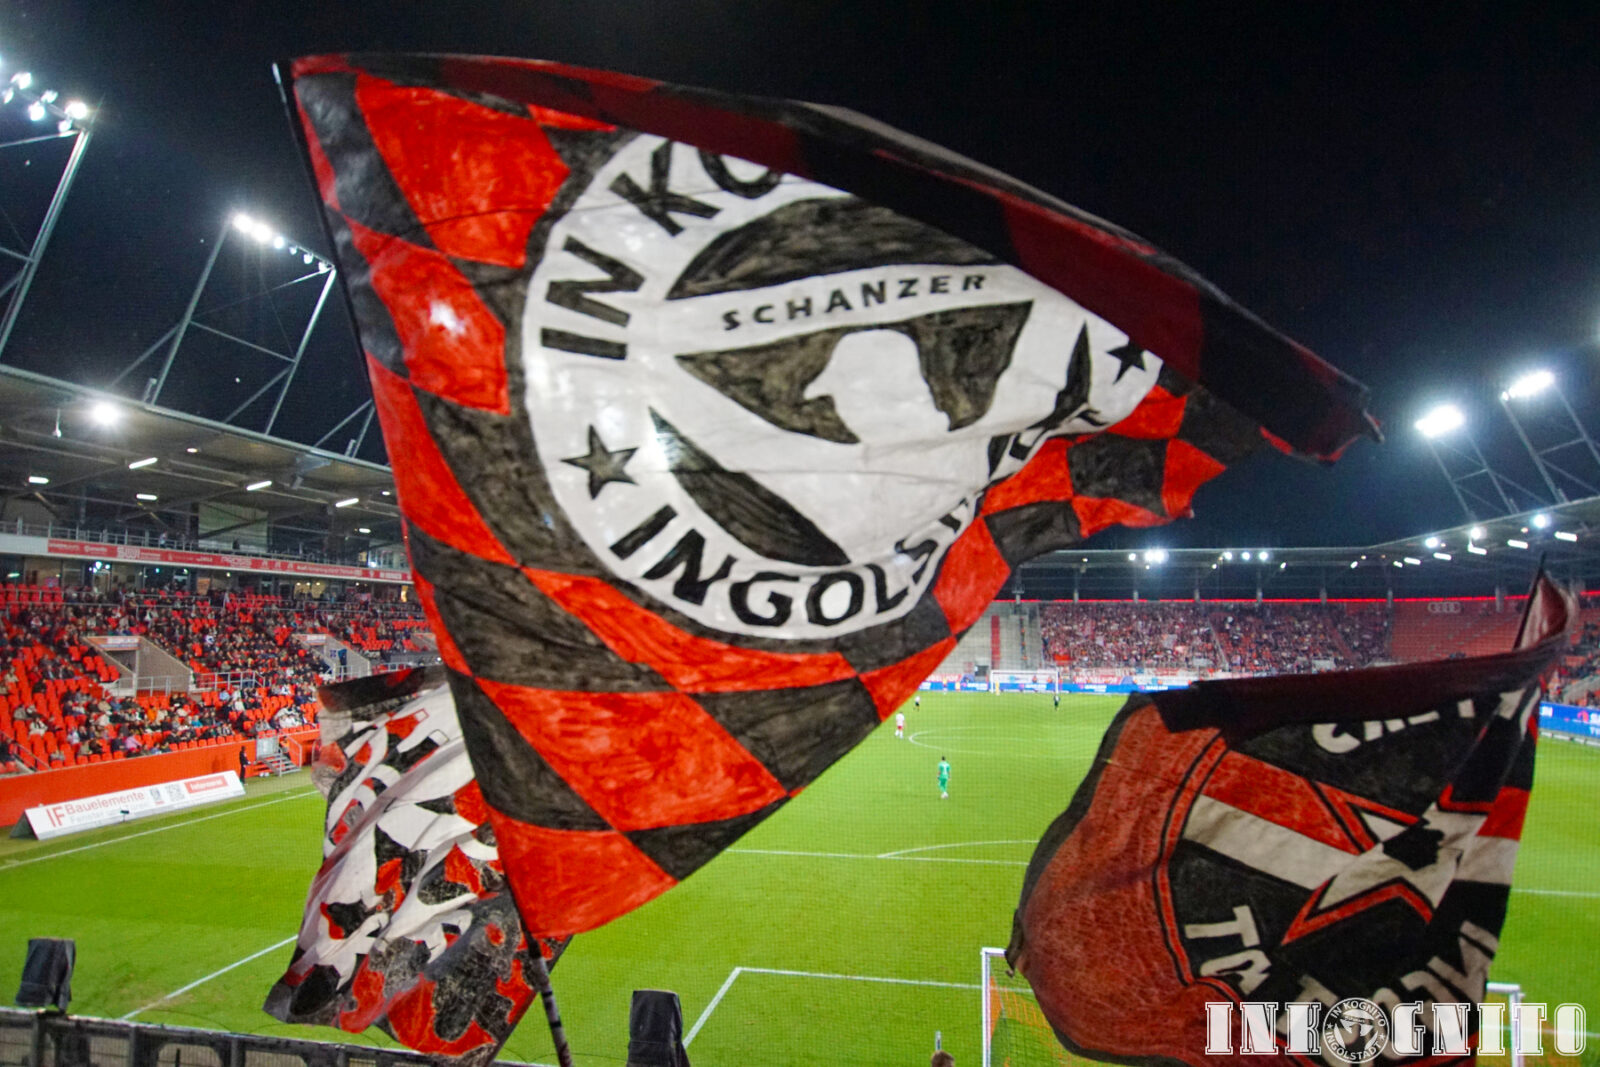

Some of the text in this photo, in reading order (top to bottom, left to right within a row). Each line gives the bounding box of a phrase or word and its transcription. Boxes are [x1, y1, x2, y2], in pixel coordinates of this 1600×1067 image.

[540, 234, 646, 361] IN
[721, 274, 987, 332] SCHANZER
[65, 790, 145, 815] Bauelemente
